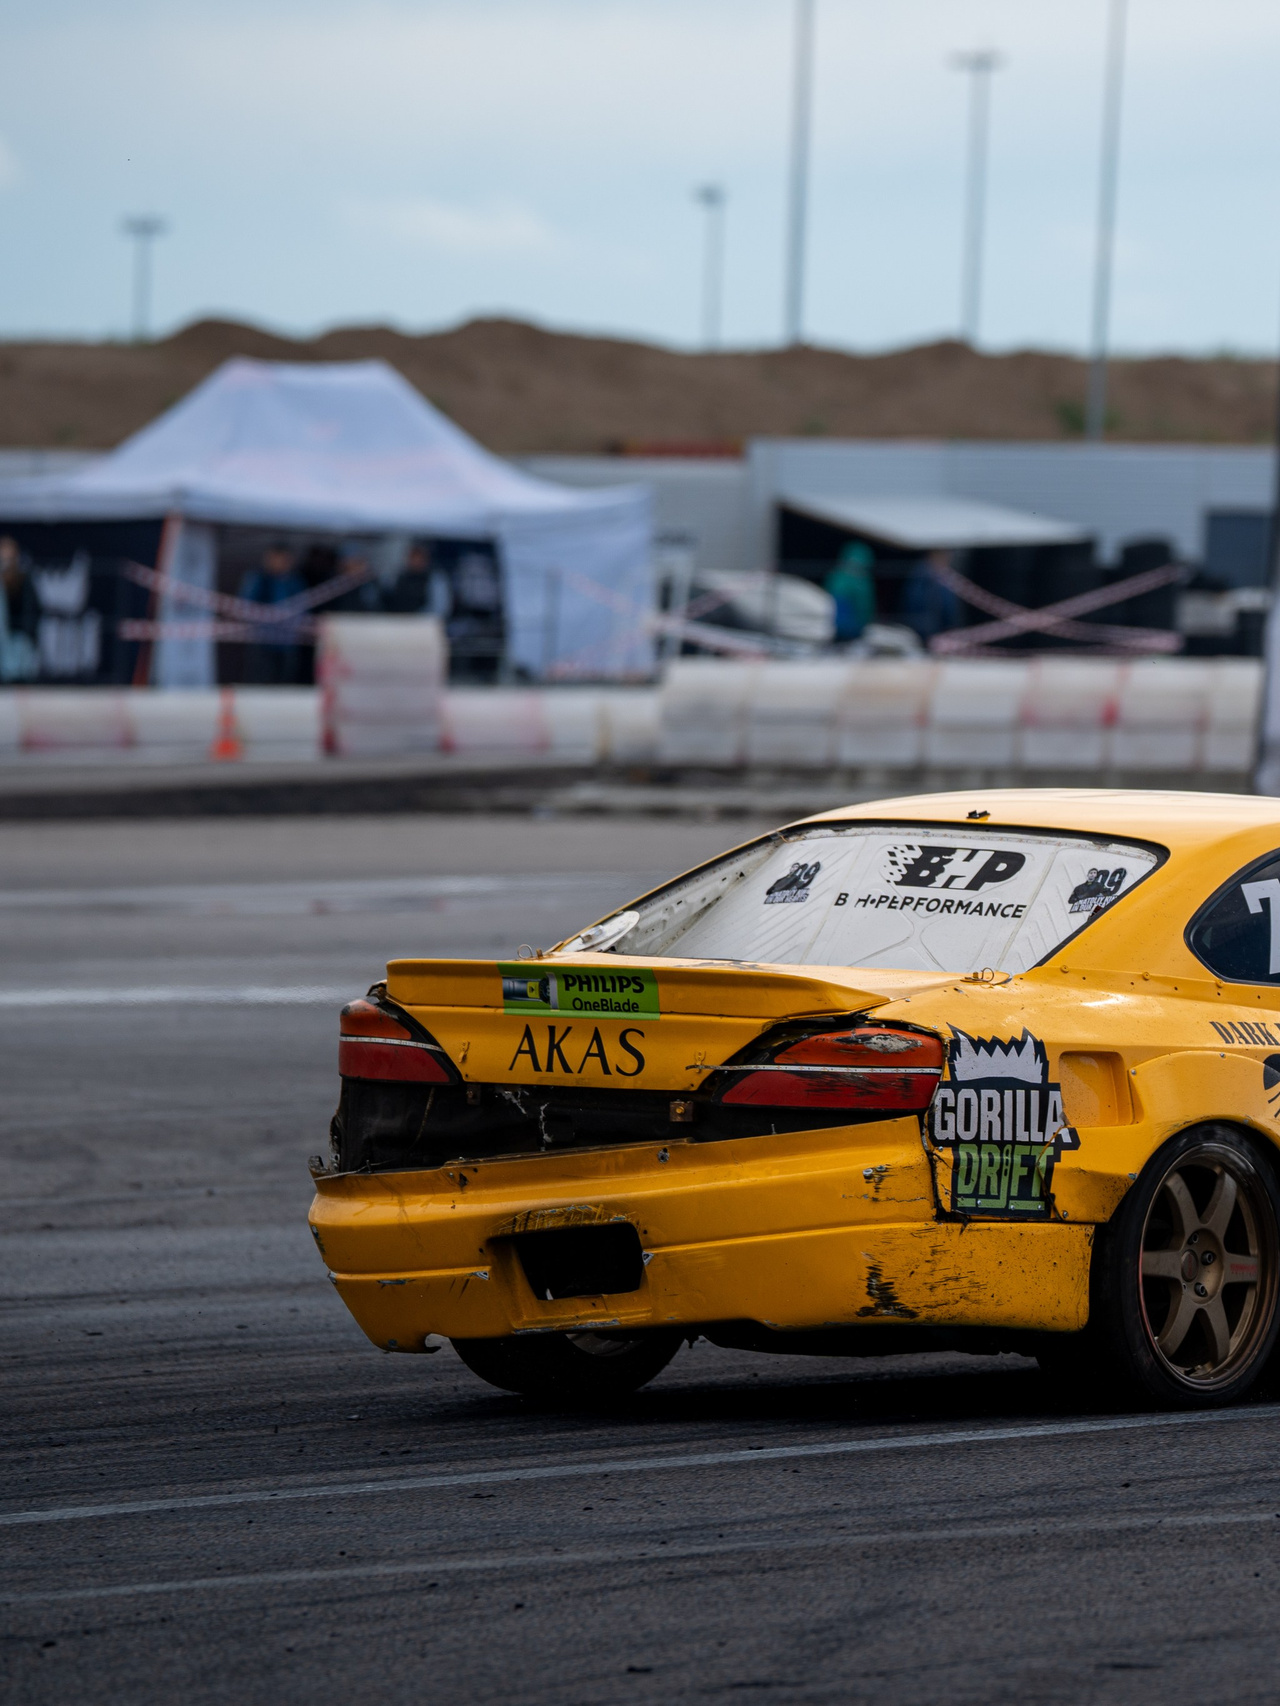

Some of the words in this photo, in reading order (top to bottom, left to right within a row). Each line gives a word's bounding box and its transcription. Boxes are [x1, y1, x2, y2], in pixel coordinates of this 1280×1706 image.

[562, 974, 645, 993] PHILIPS
[572, 997, 640, 1013] OneBlade
[508, 1023, 646, 1077] AKAS
[1209, 1021, 1280, 1047] DARK
[933, 1088, 1072, 1143] GORILLA
[957, 1143, 1055, 1209] DRIFT
